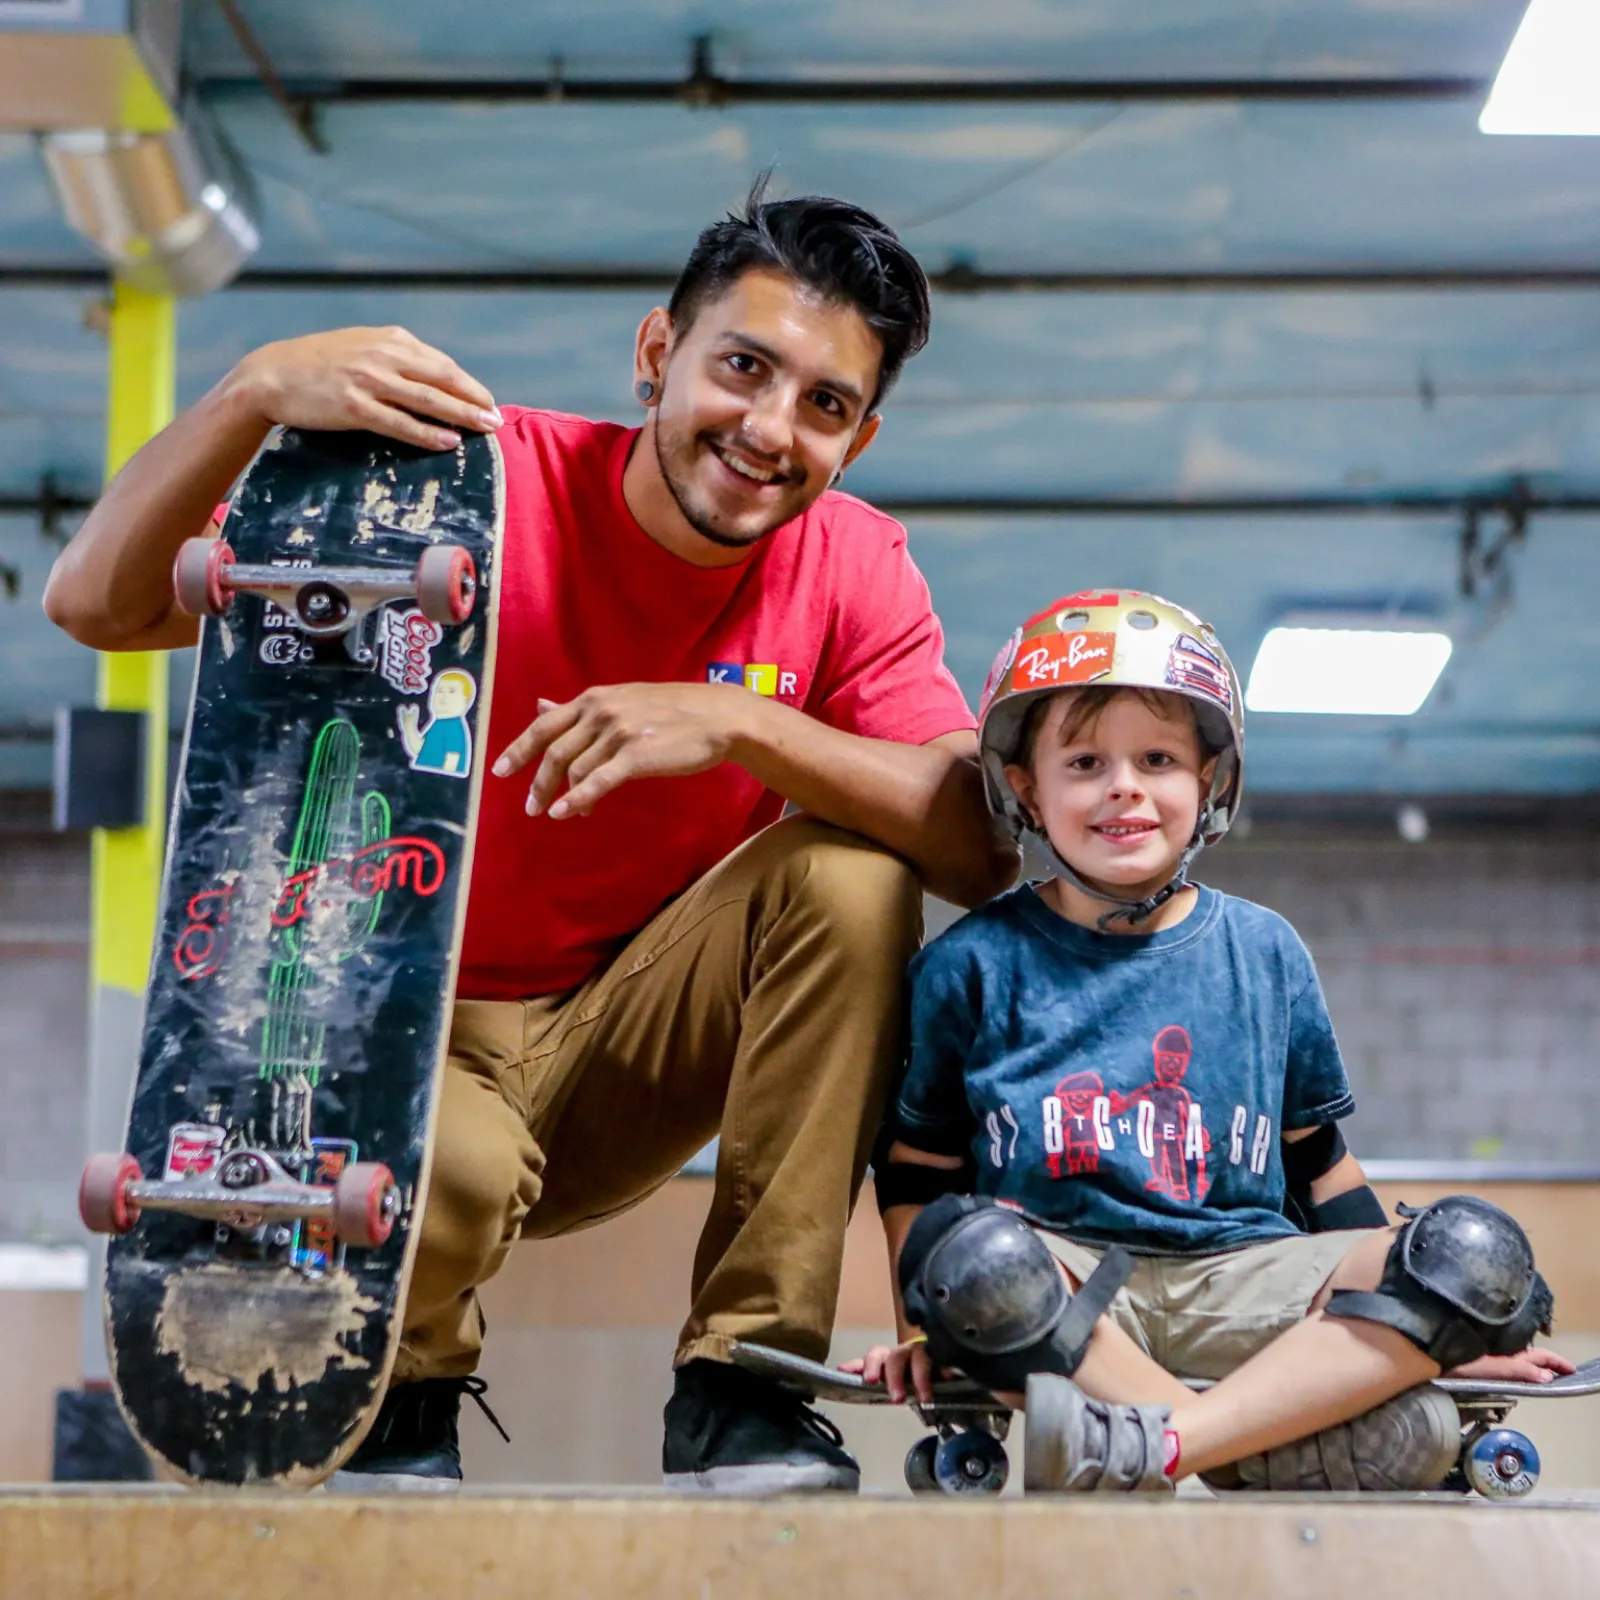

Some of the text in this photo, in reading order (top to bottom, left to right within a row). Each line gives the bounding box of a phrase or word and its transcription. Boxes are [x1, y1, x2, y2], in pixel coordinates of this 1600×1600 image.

[385, 609, 407, 685] LIGHT
[405, 615, 438, 688] Coors
[1018, 635, 1108, 682] Ray-Ban
